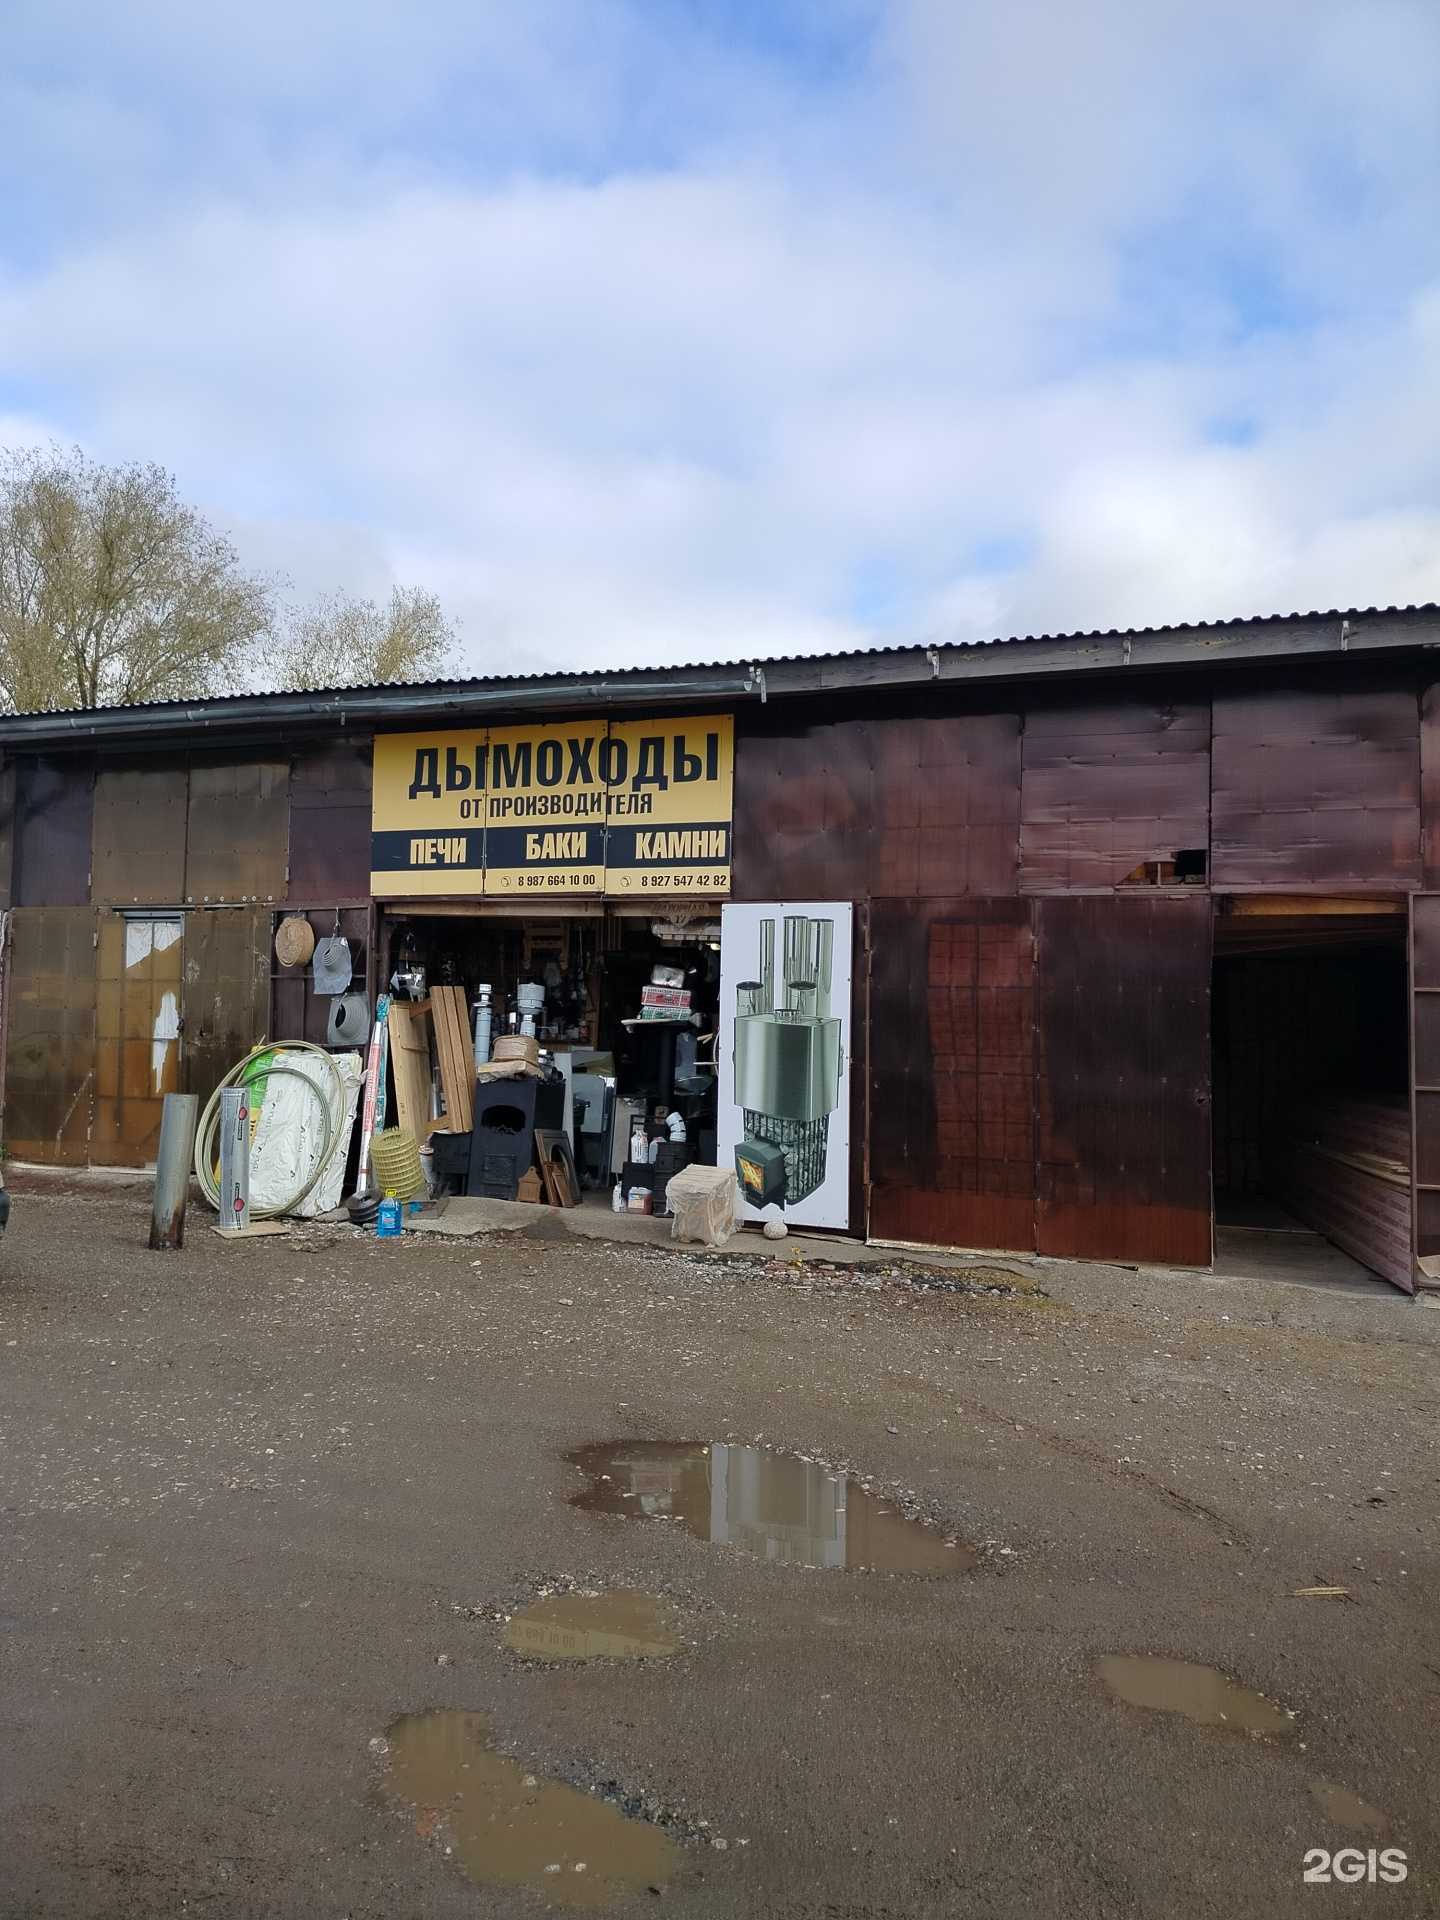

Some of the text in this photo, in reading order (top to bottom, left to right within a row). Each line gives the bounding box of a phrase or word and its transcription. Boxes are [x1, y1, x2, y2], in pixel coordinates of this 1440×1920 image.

[409, 733, 719, 800] ДЫМОХОДЫ
[460, 792, 653, 819] ОТ ПРОИЗВОДИТЕЛЯ
[410, 837, 467, 864] ПЕЧИ
[526, 831, 587, 860] БАКИ
[635, 830, 726, 859] КАМНИ
[518, 874, 596, 886] 8 987 664 10 00
[641, 874, 727, 887] 8 927 547 42 82
